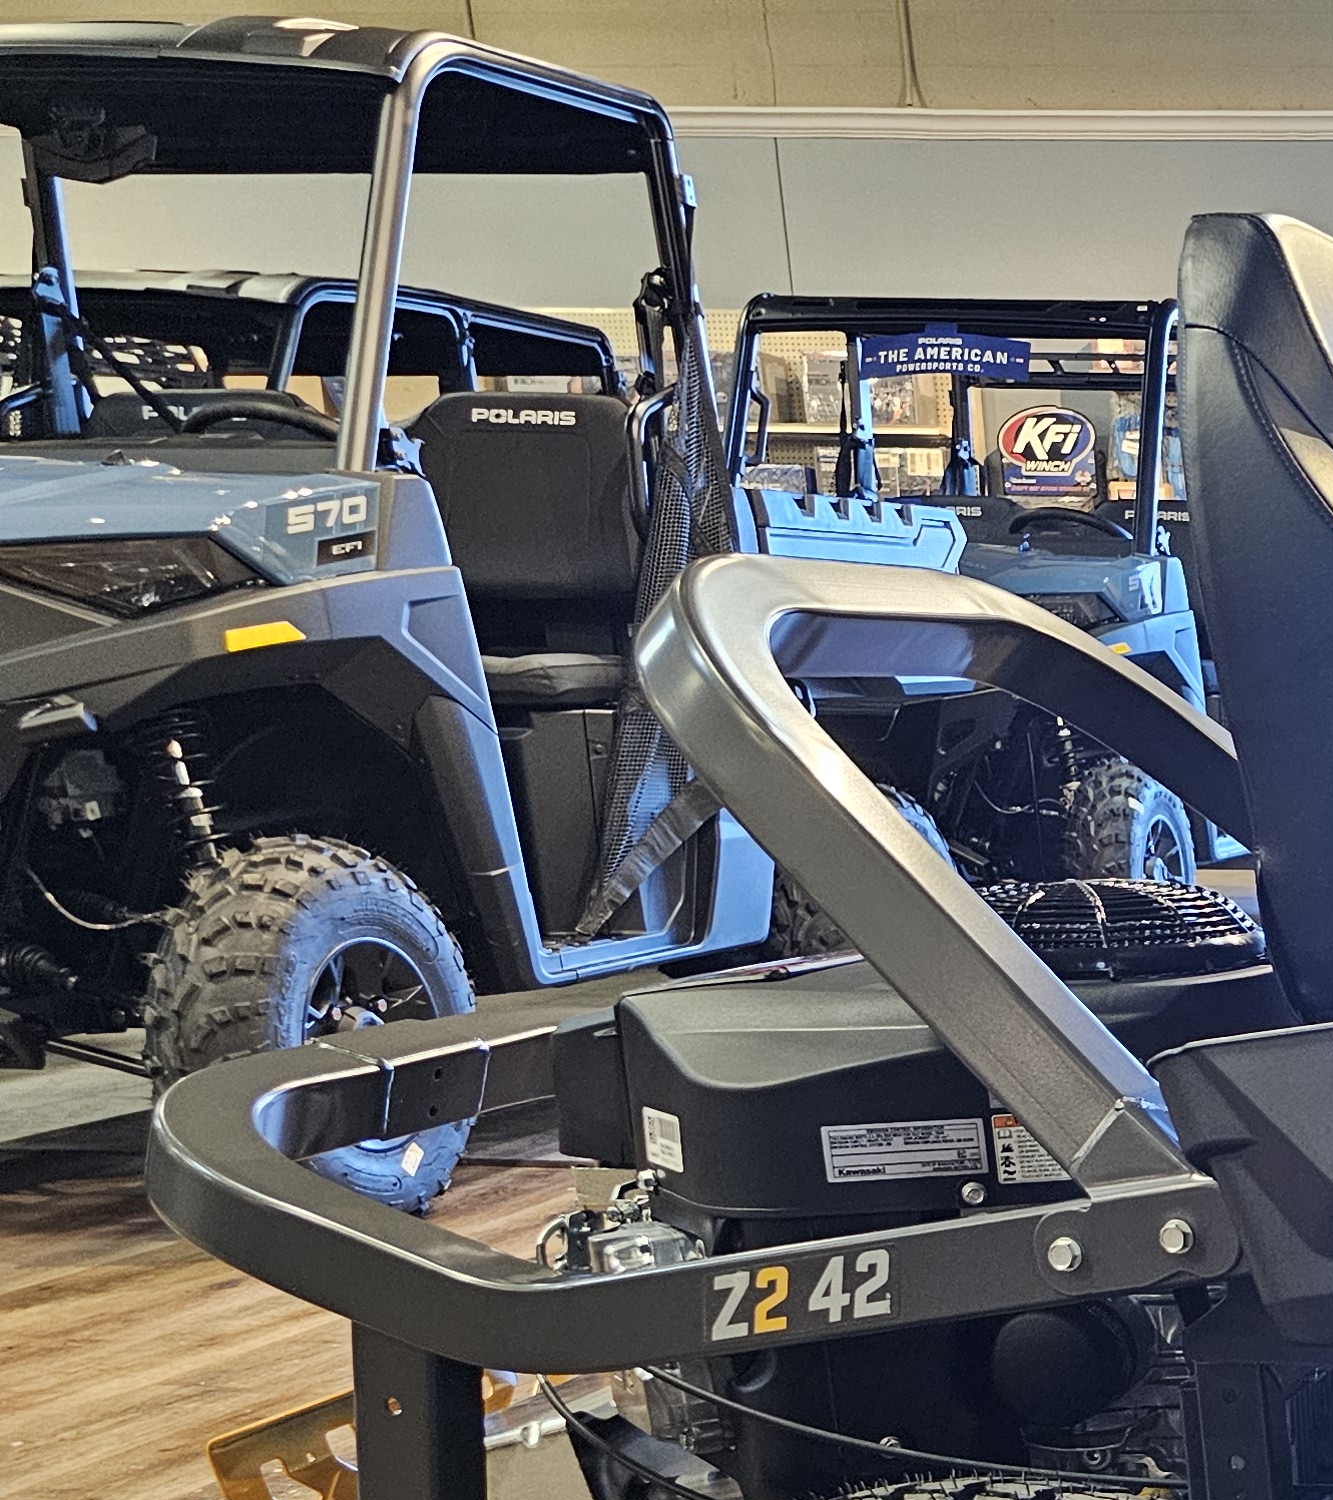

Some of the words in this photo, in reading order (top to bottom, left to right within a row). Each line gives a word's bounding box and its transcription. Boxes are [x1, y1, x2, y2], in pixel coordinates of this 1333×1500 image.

[878, 351, 908, 364] THE
[914, 346, 1008, 365] AMERICAN
[896, 361, 964, 373] POWERSPORTS
[471, 407, 577, 426] POLARIS
[1025, 460, 1073, 474] WINCH
[286, 495, 367, 535] 570
[838, 1166, 886, 1178] Kawasaki
[711, 1265, 789, 1342] Z2
[808, 1248, 892, 1323] 42
